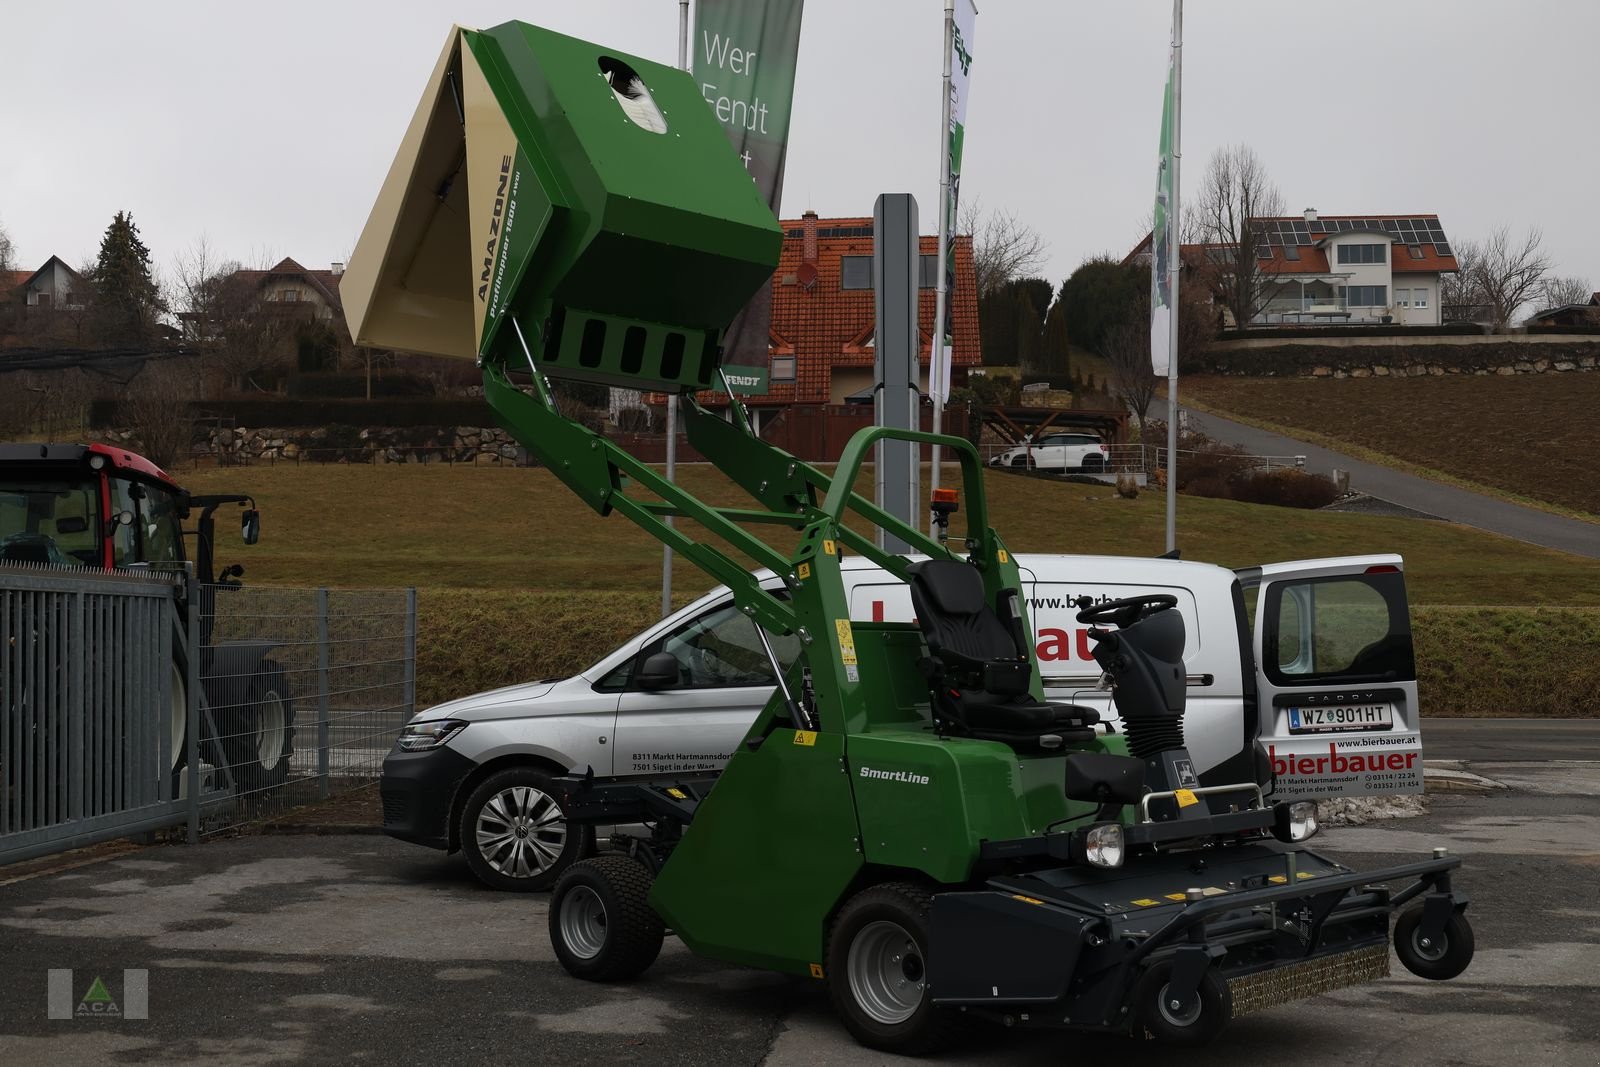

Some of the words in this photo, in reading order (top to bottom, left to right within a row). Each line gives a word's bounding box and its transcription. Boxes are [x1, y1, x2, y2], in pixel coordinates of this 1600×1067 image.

[704, 30, 756, 76] Wer
[702, 83, 769, 135] Fendt
[478, 155, 512, 303] AMAZONE
[490, 236, 510, 319] Profihopper
[505, 199, 517, 233] 1500
[726, 375, 760, 386] FENDT
[1302, 709, 1324, 725] WZ
[1336, 706, 1384, 723] 901HT
[1337, 736, 1416, 748] www.bierbauer.at
[632, 753, 651, 761] 8311
[652, 753, 675, 761] Markt
[1269, 742, 1418, 775] bierbauer
[632, 763, 651, 771] 7501
[652, 763, 672, 772] Siget
[860, 766, 930, 785] SmartLine
[1288, 776, 1307, 784] Markt
[1308, 775, 1359, 784] Hartmannsdorf
[1288, 785, 1306, 795] Siget
[1307, 785, 1314, 793] in
[1315, 785, 1327, 793] der
